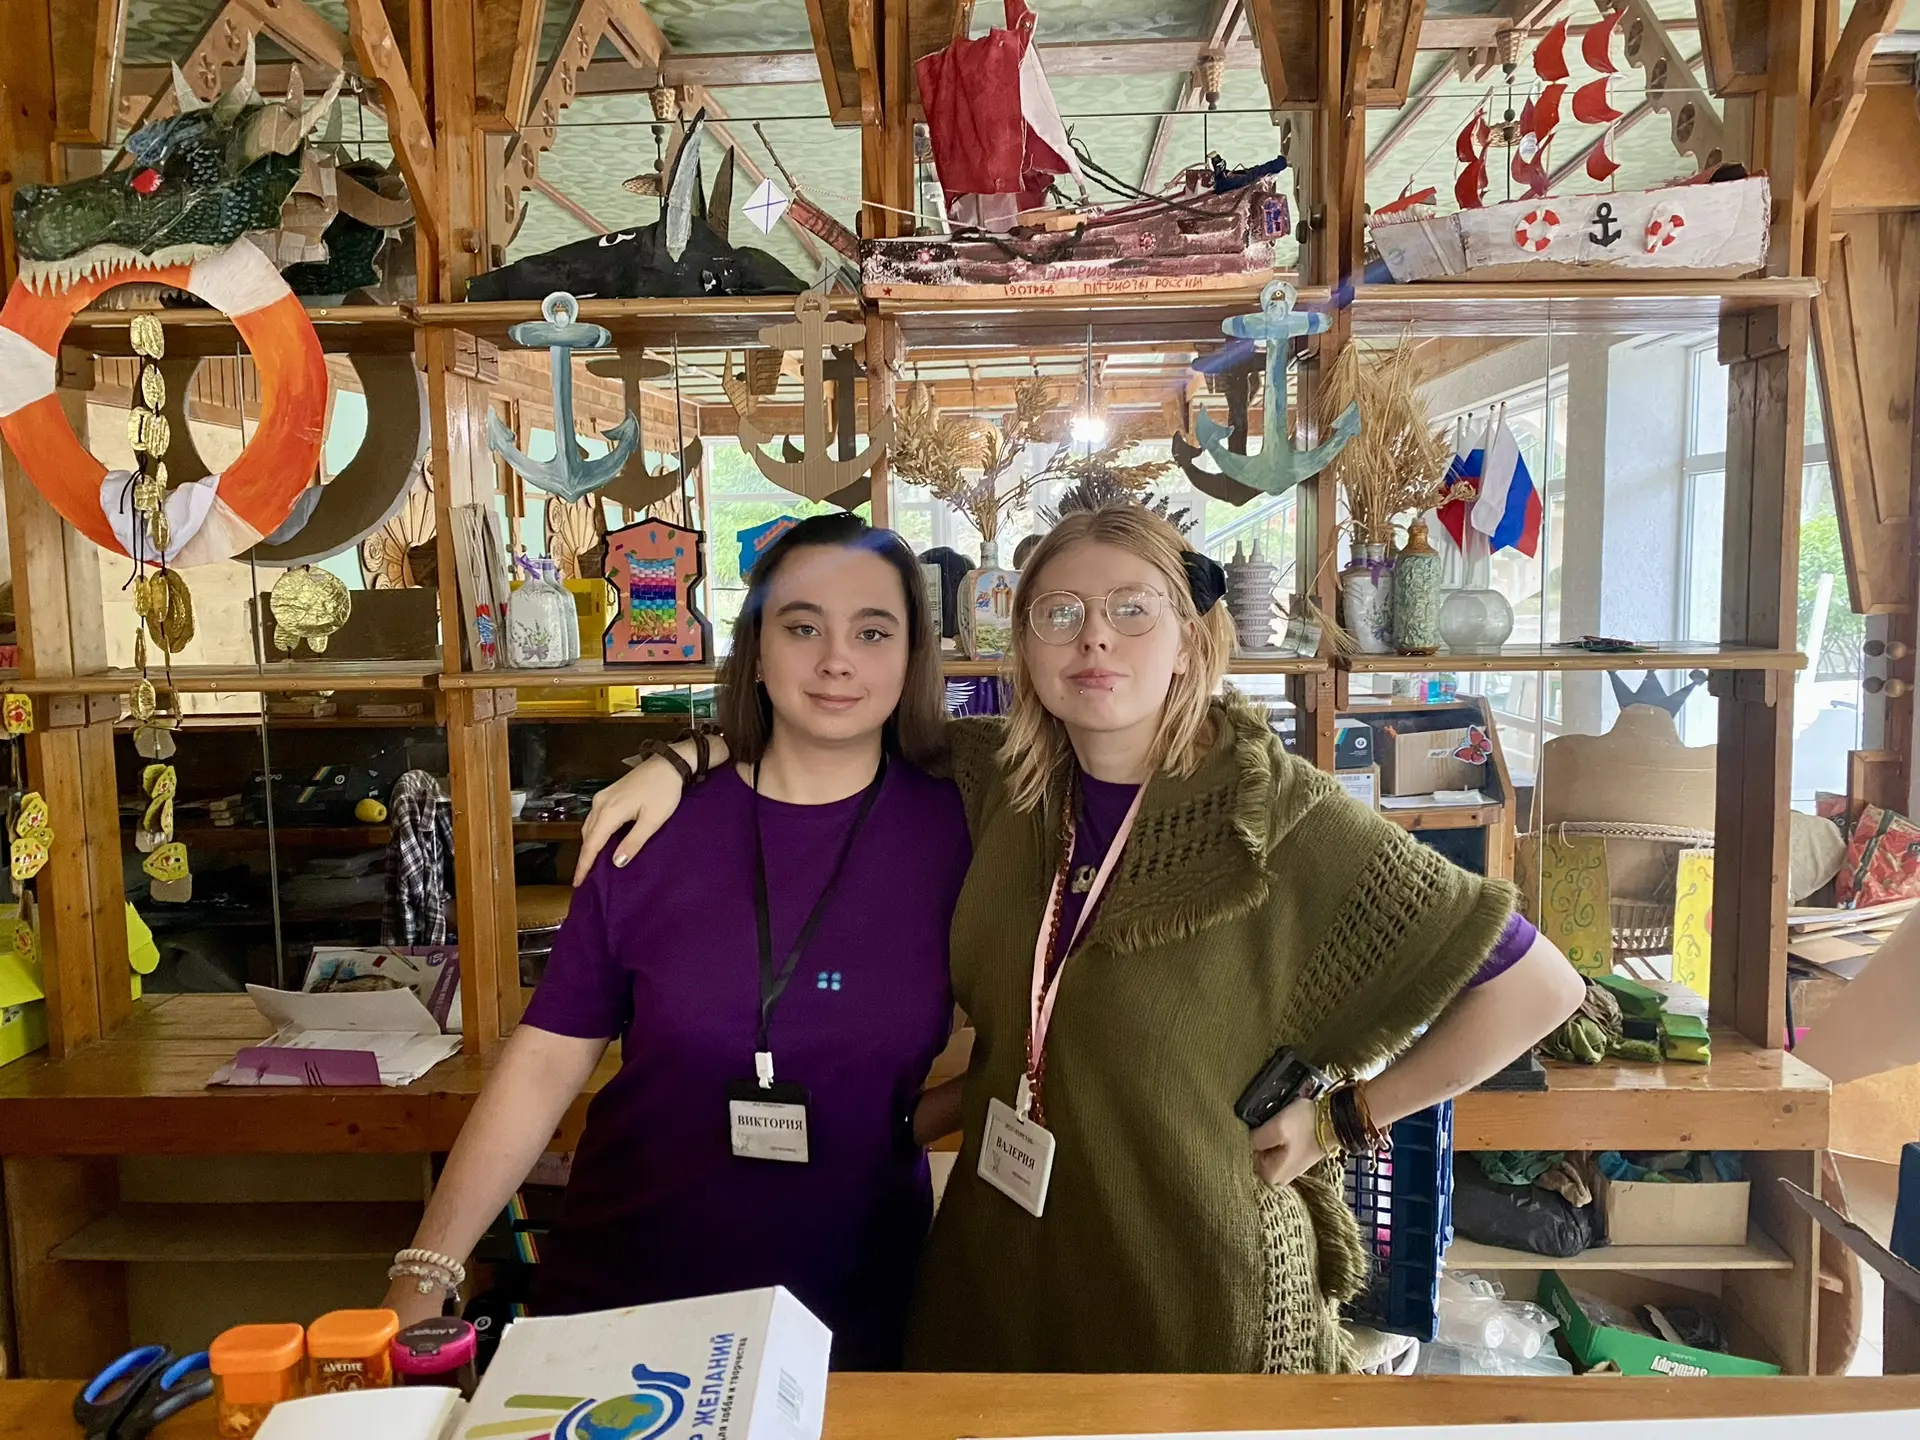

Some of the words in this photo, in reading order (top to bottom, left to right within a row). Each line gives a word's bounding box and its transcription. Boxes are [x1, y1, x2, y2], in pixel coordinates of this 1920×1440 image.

[1083, 279, 1148, 295] ПАТРИОТЫ
[1155, 276, 1203, 289] РОССИИ
[737, 1114, 803, 1131] ВИКТОРИЯ
[996, 1135, 1036, 1171] ВАЛЕРИЯ
[692, 1332, 735, 1428] ЖЕЛАНИЙ
[720, 1395, 735, 1423] хобби
